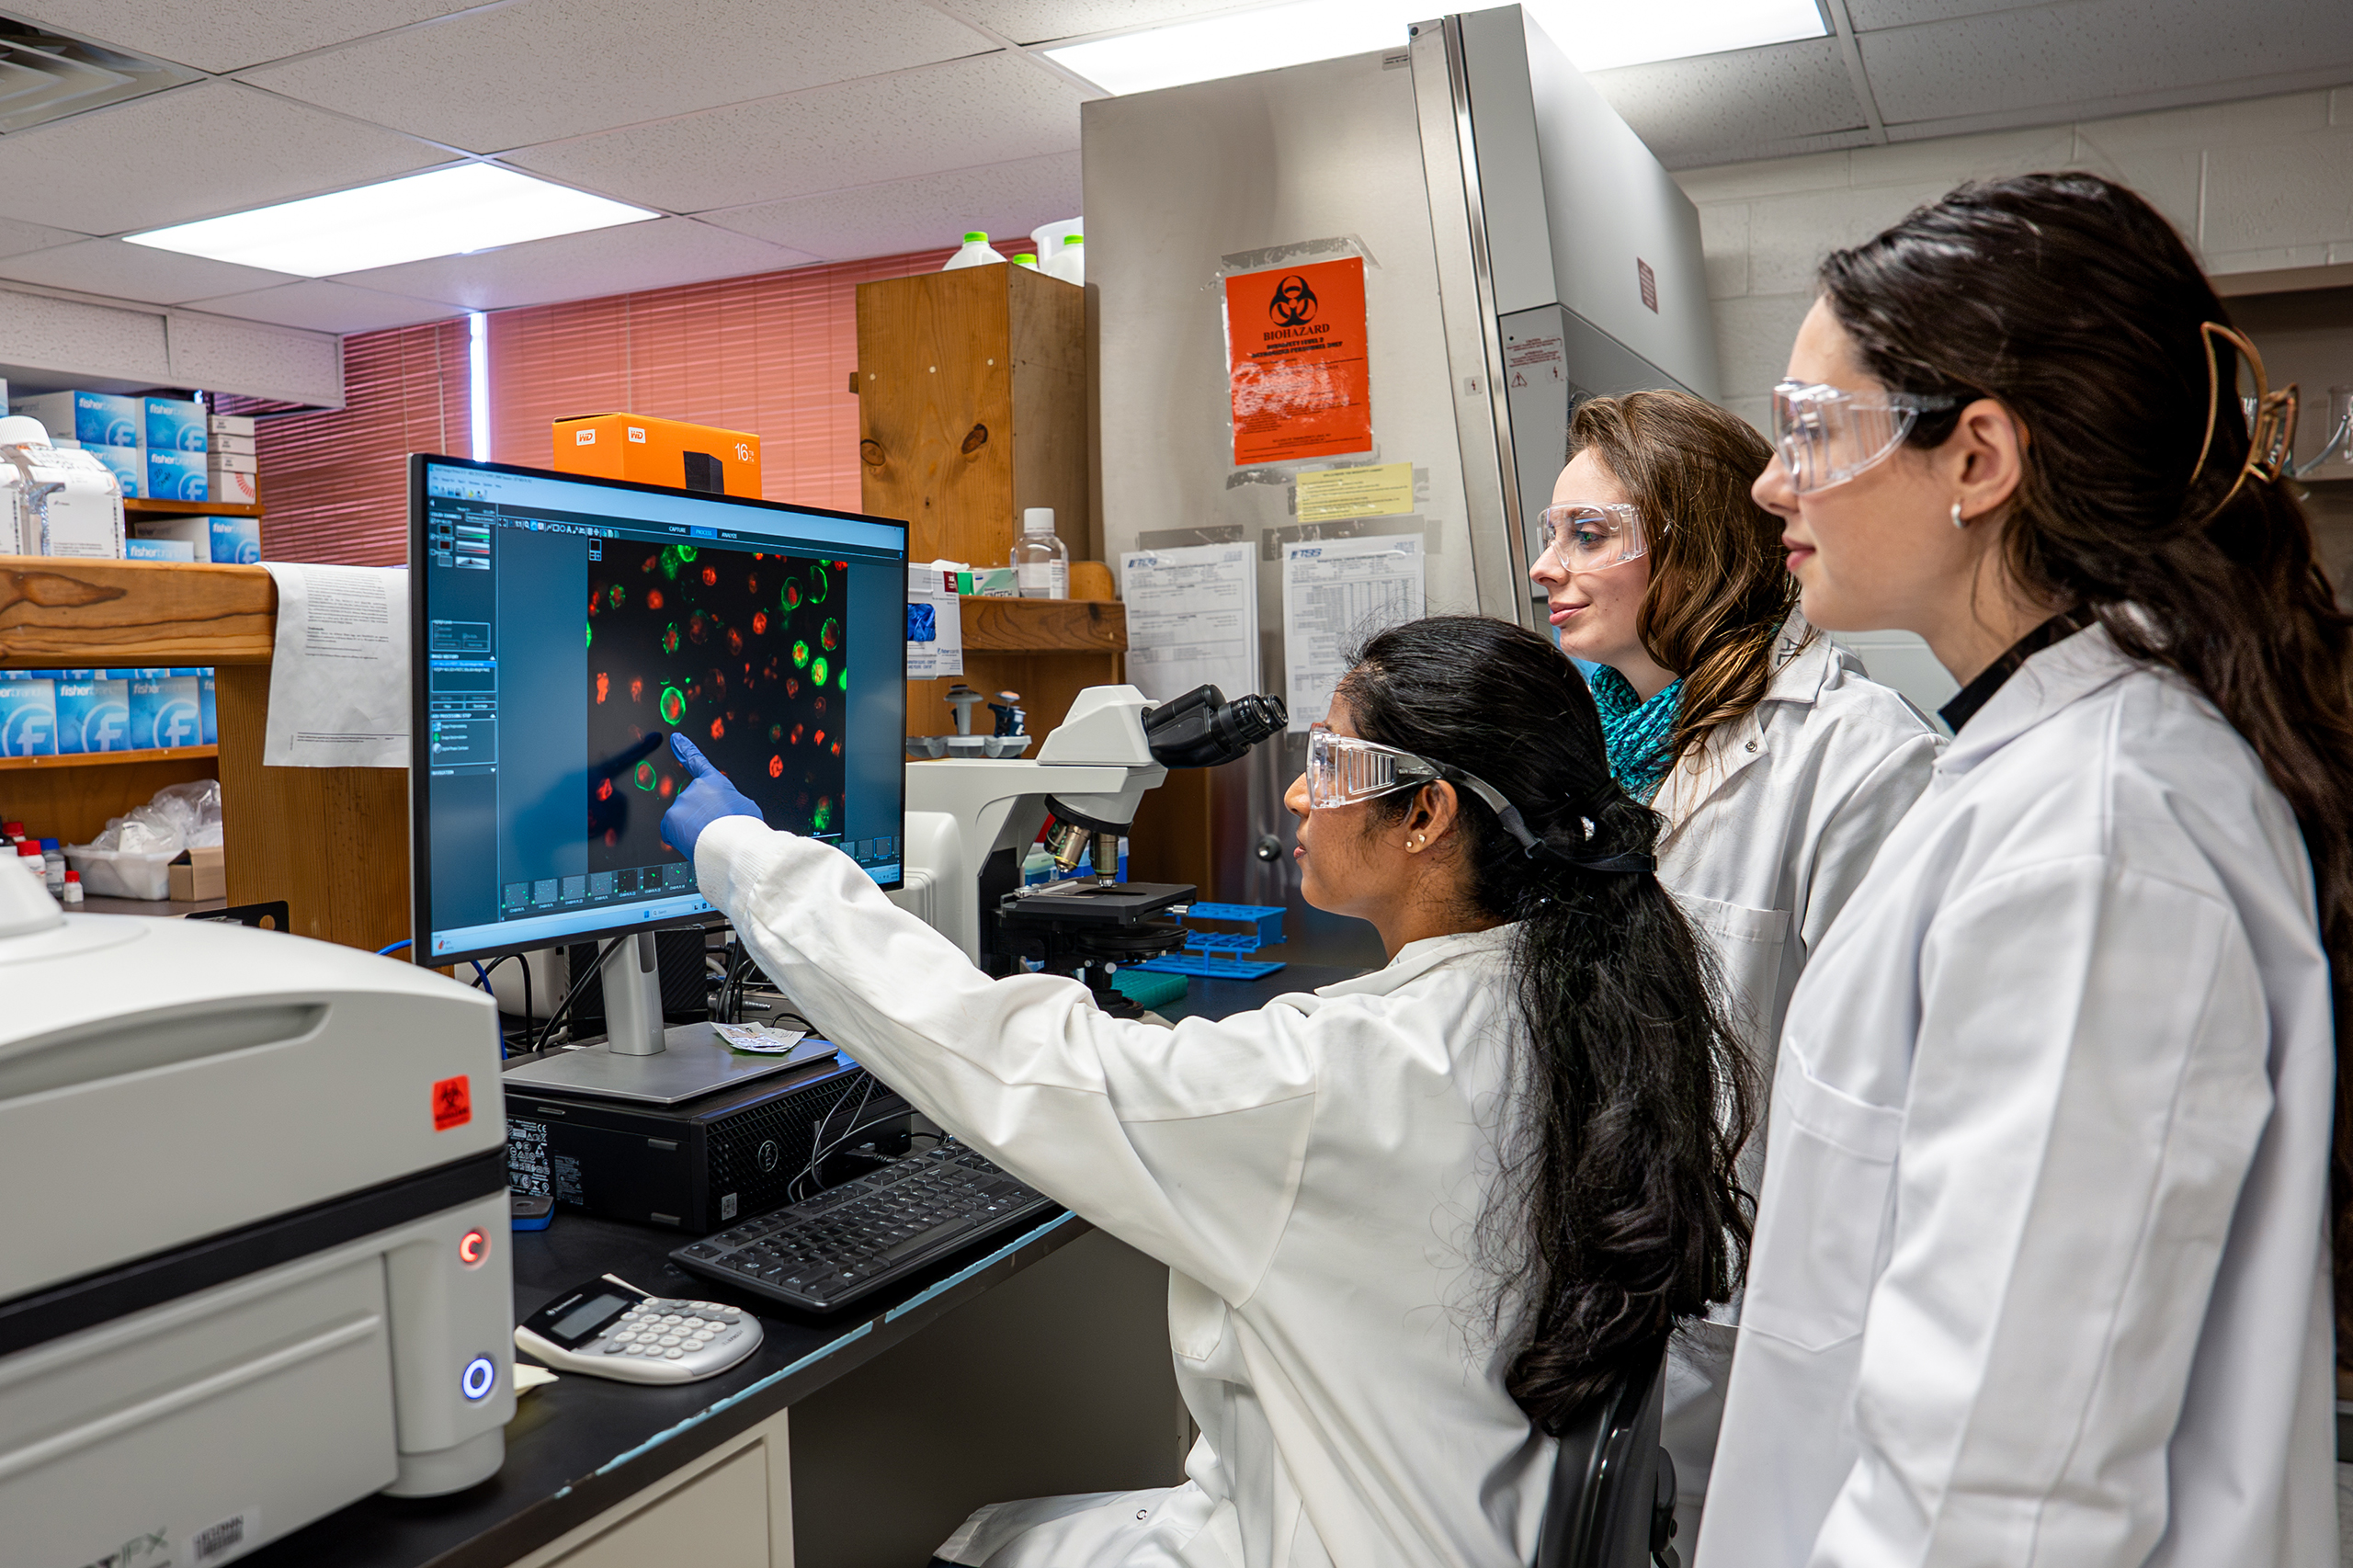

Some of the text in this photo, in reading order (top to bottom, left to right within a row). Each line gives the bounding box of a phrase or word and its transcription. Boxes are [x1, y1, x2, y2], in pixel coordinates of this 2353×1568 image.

[1264, 324, 1330, 341] BIOHAZARD
[578, 432, 593, 443] WD
[631, 430, 643, 440] WD
[734, 443, 749, 461] 16
